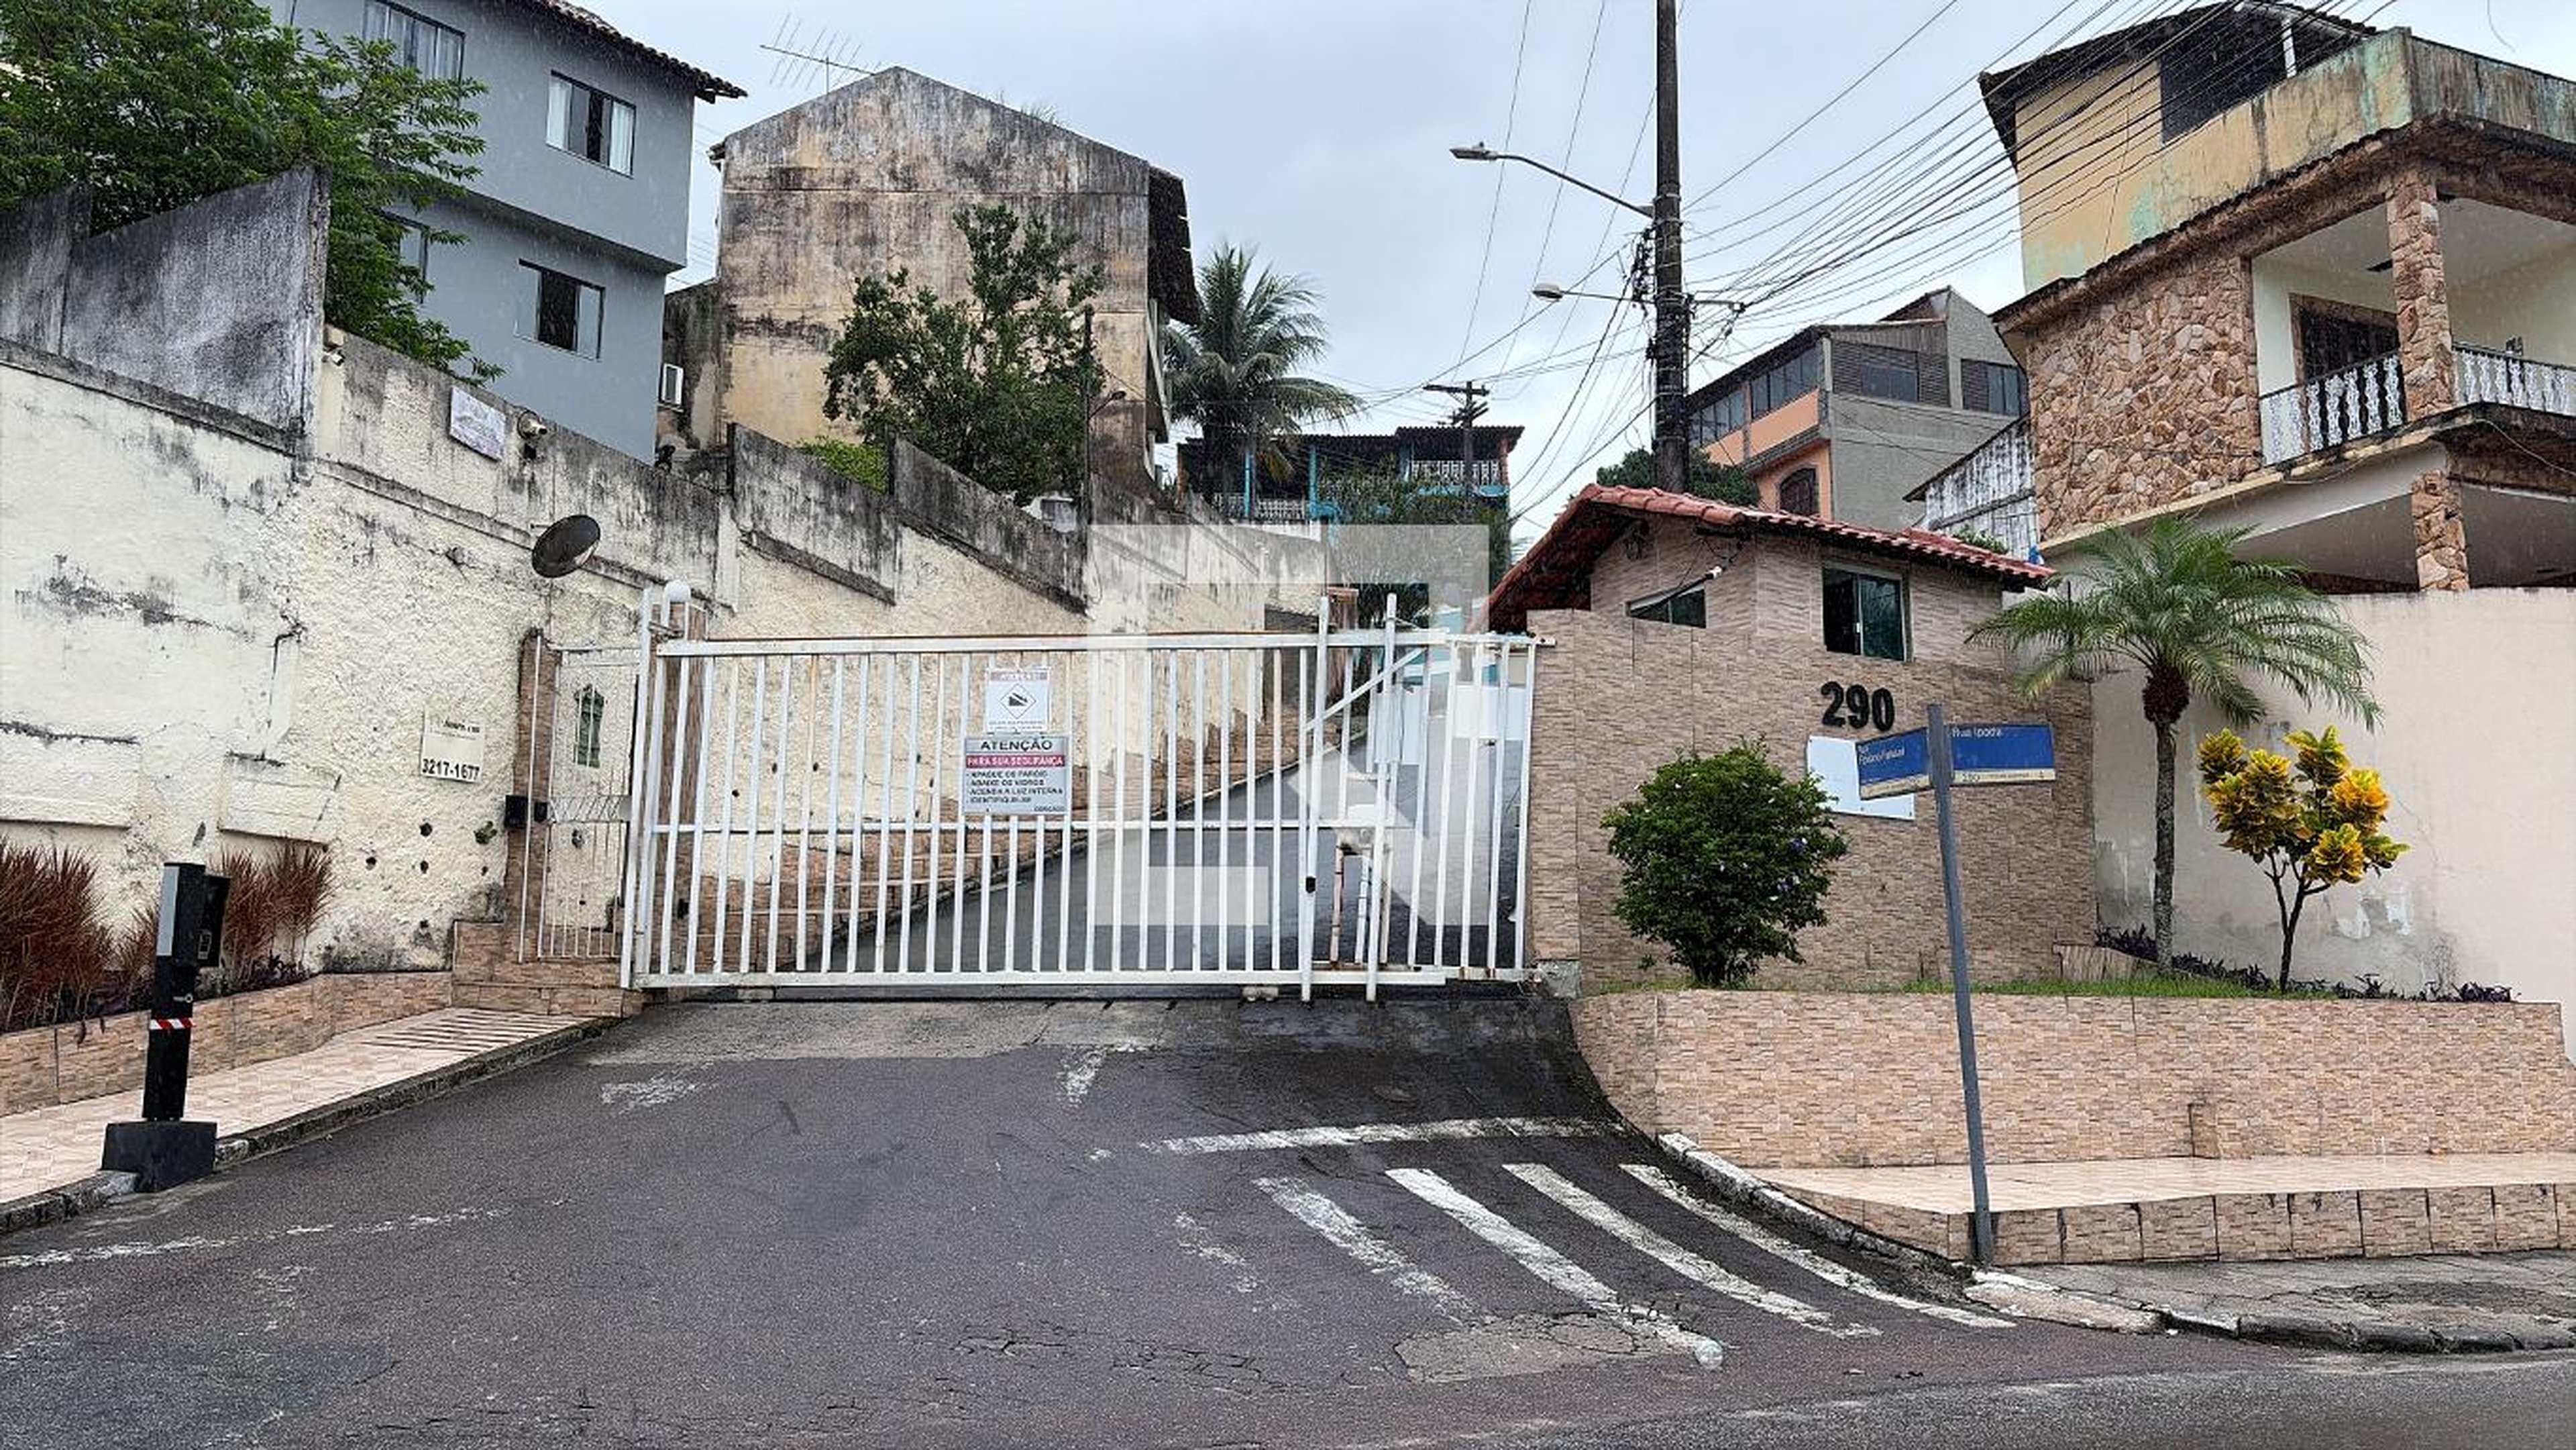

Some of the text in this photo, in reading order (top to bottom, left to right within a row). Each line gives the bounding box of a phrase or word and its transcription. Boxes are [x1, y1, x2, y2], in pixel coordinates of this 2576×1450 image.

[1821, 681, 1894, 731] 290
[981, 738, 1053, 752] ATENÇÃO
[422, 758, 480, 780] 3217-1677
